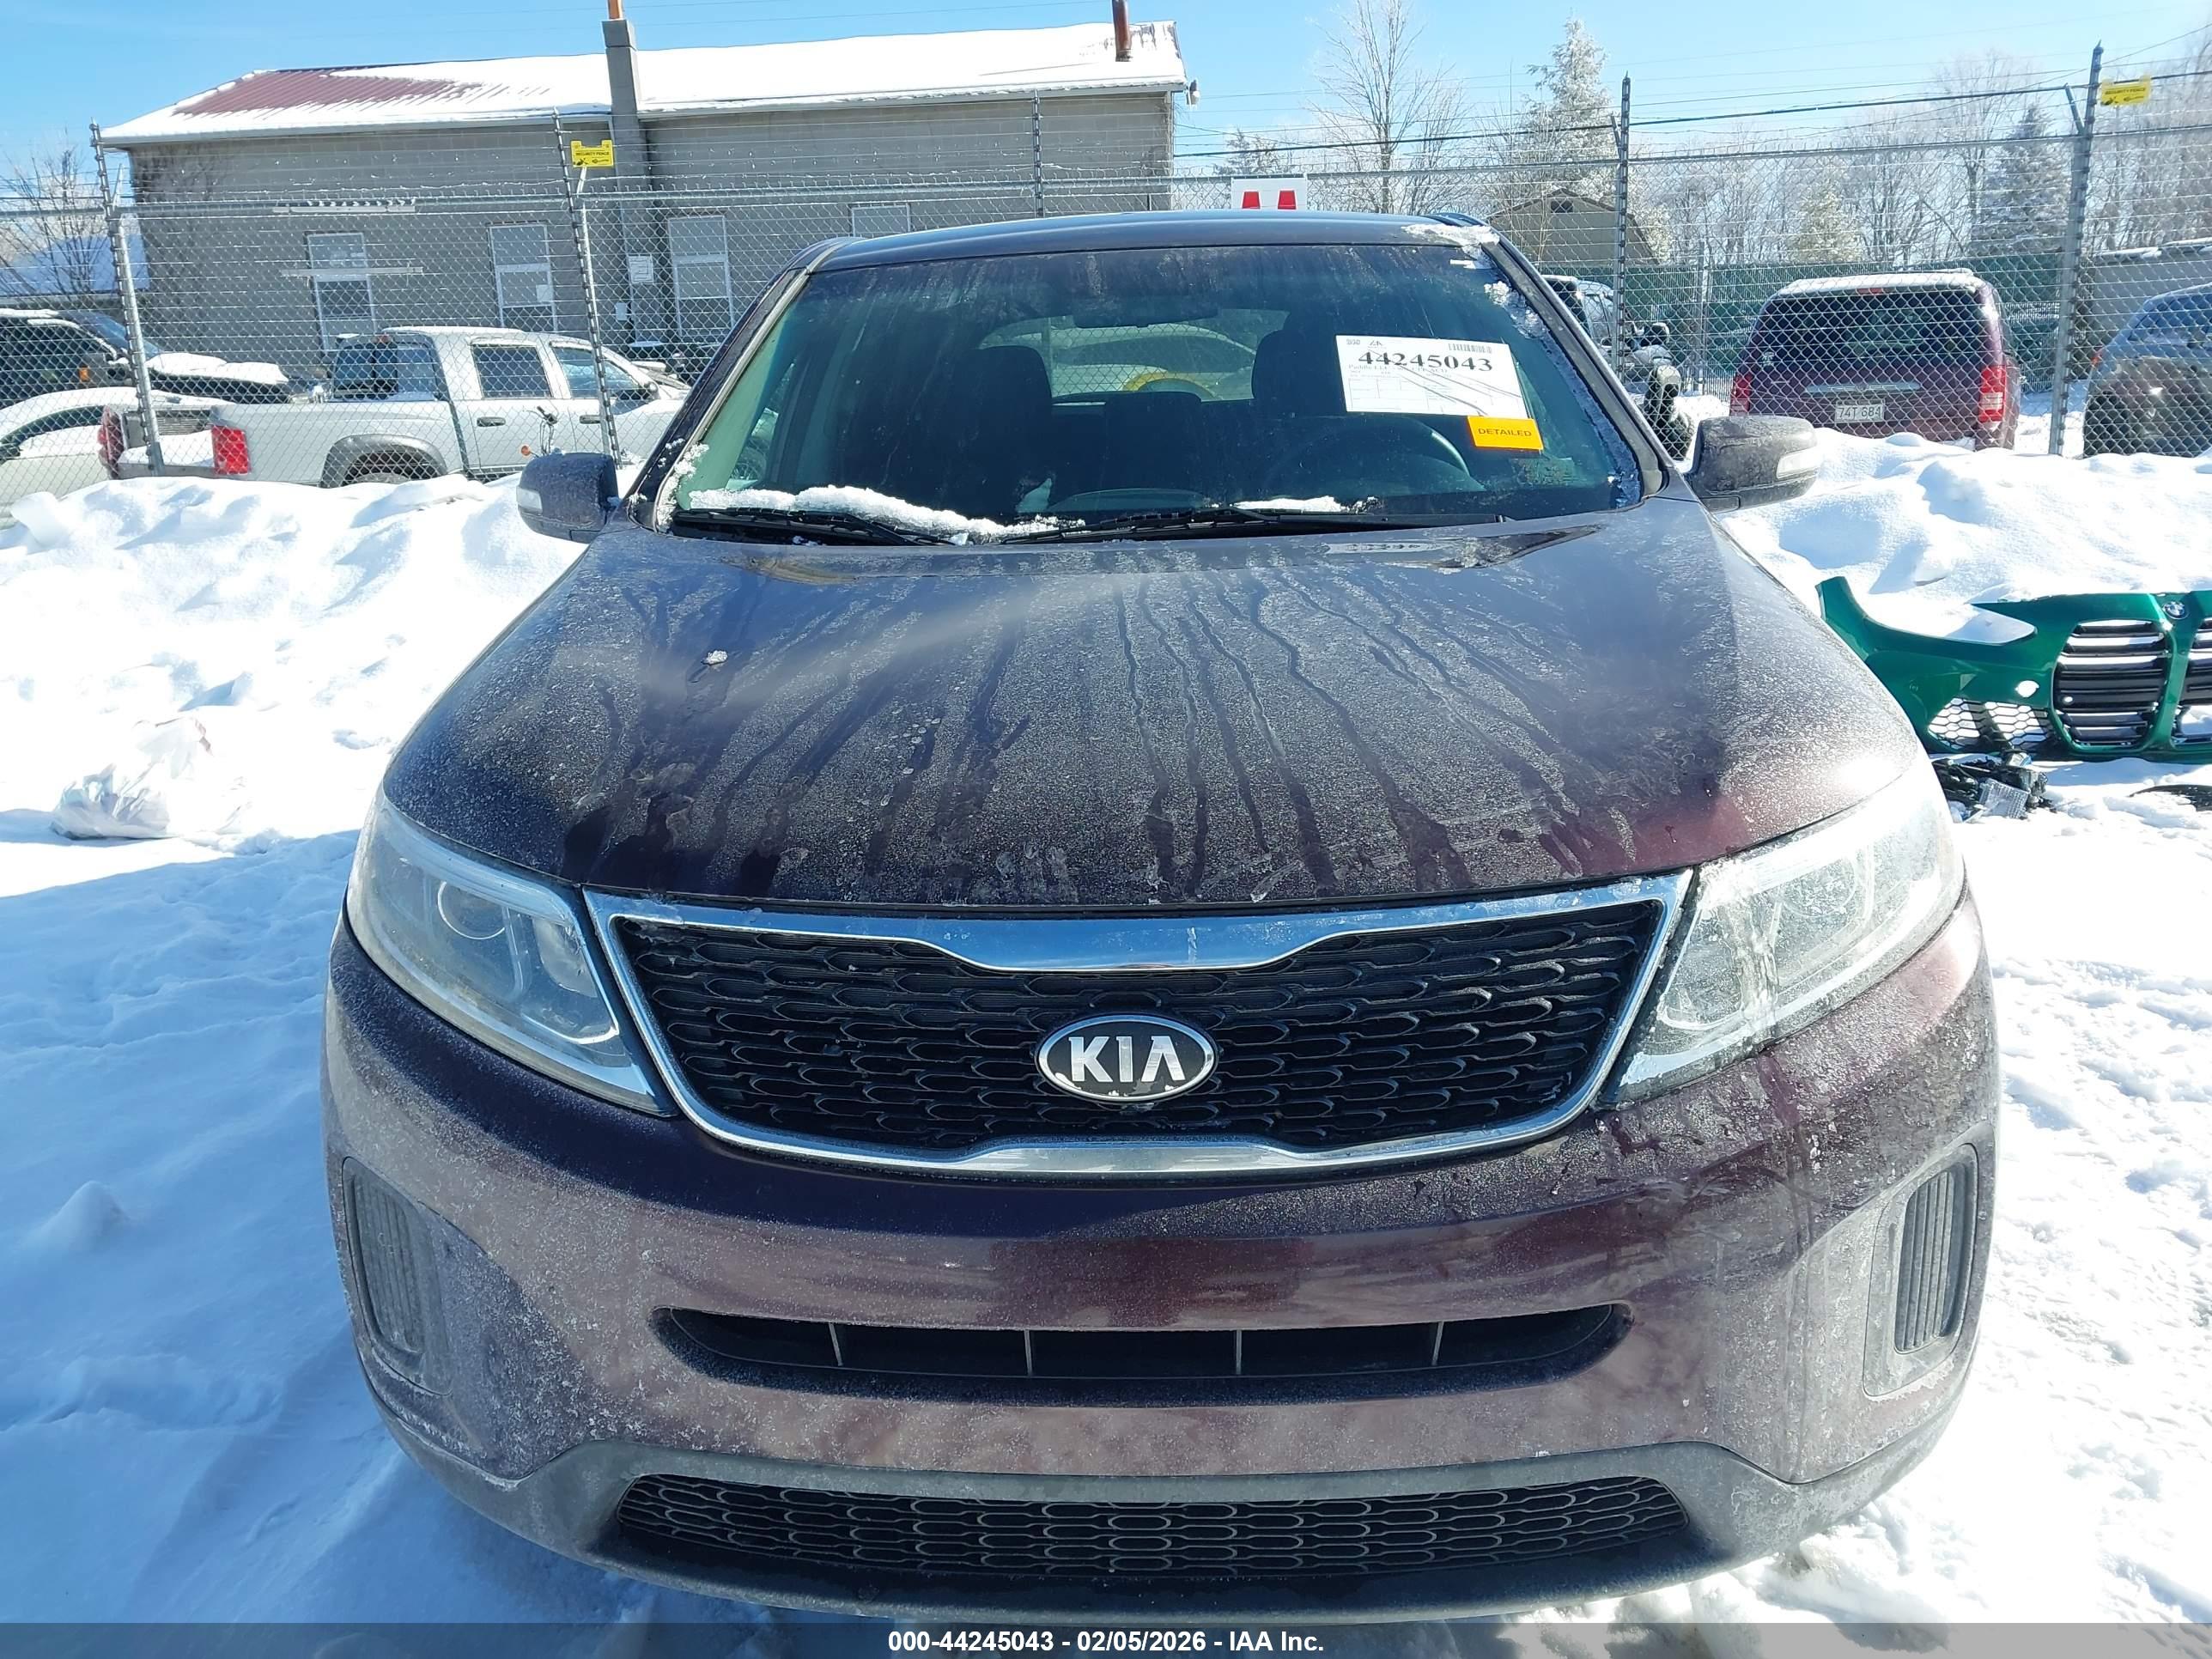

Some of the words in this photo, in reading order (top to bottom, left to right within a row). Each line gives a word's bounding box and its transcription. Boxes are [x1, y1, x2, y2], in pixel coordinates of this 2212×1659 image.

[1358, 351, 1493, 373] 44245043
[1478, 428, 1533, 437] DETAILED
[1068, 1036, 1186, 1083] KIA
